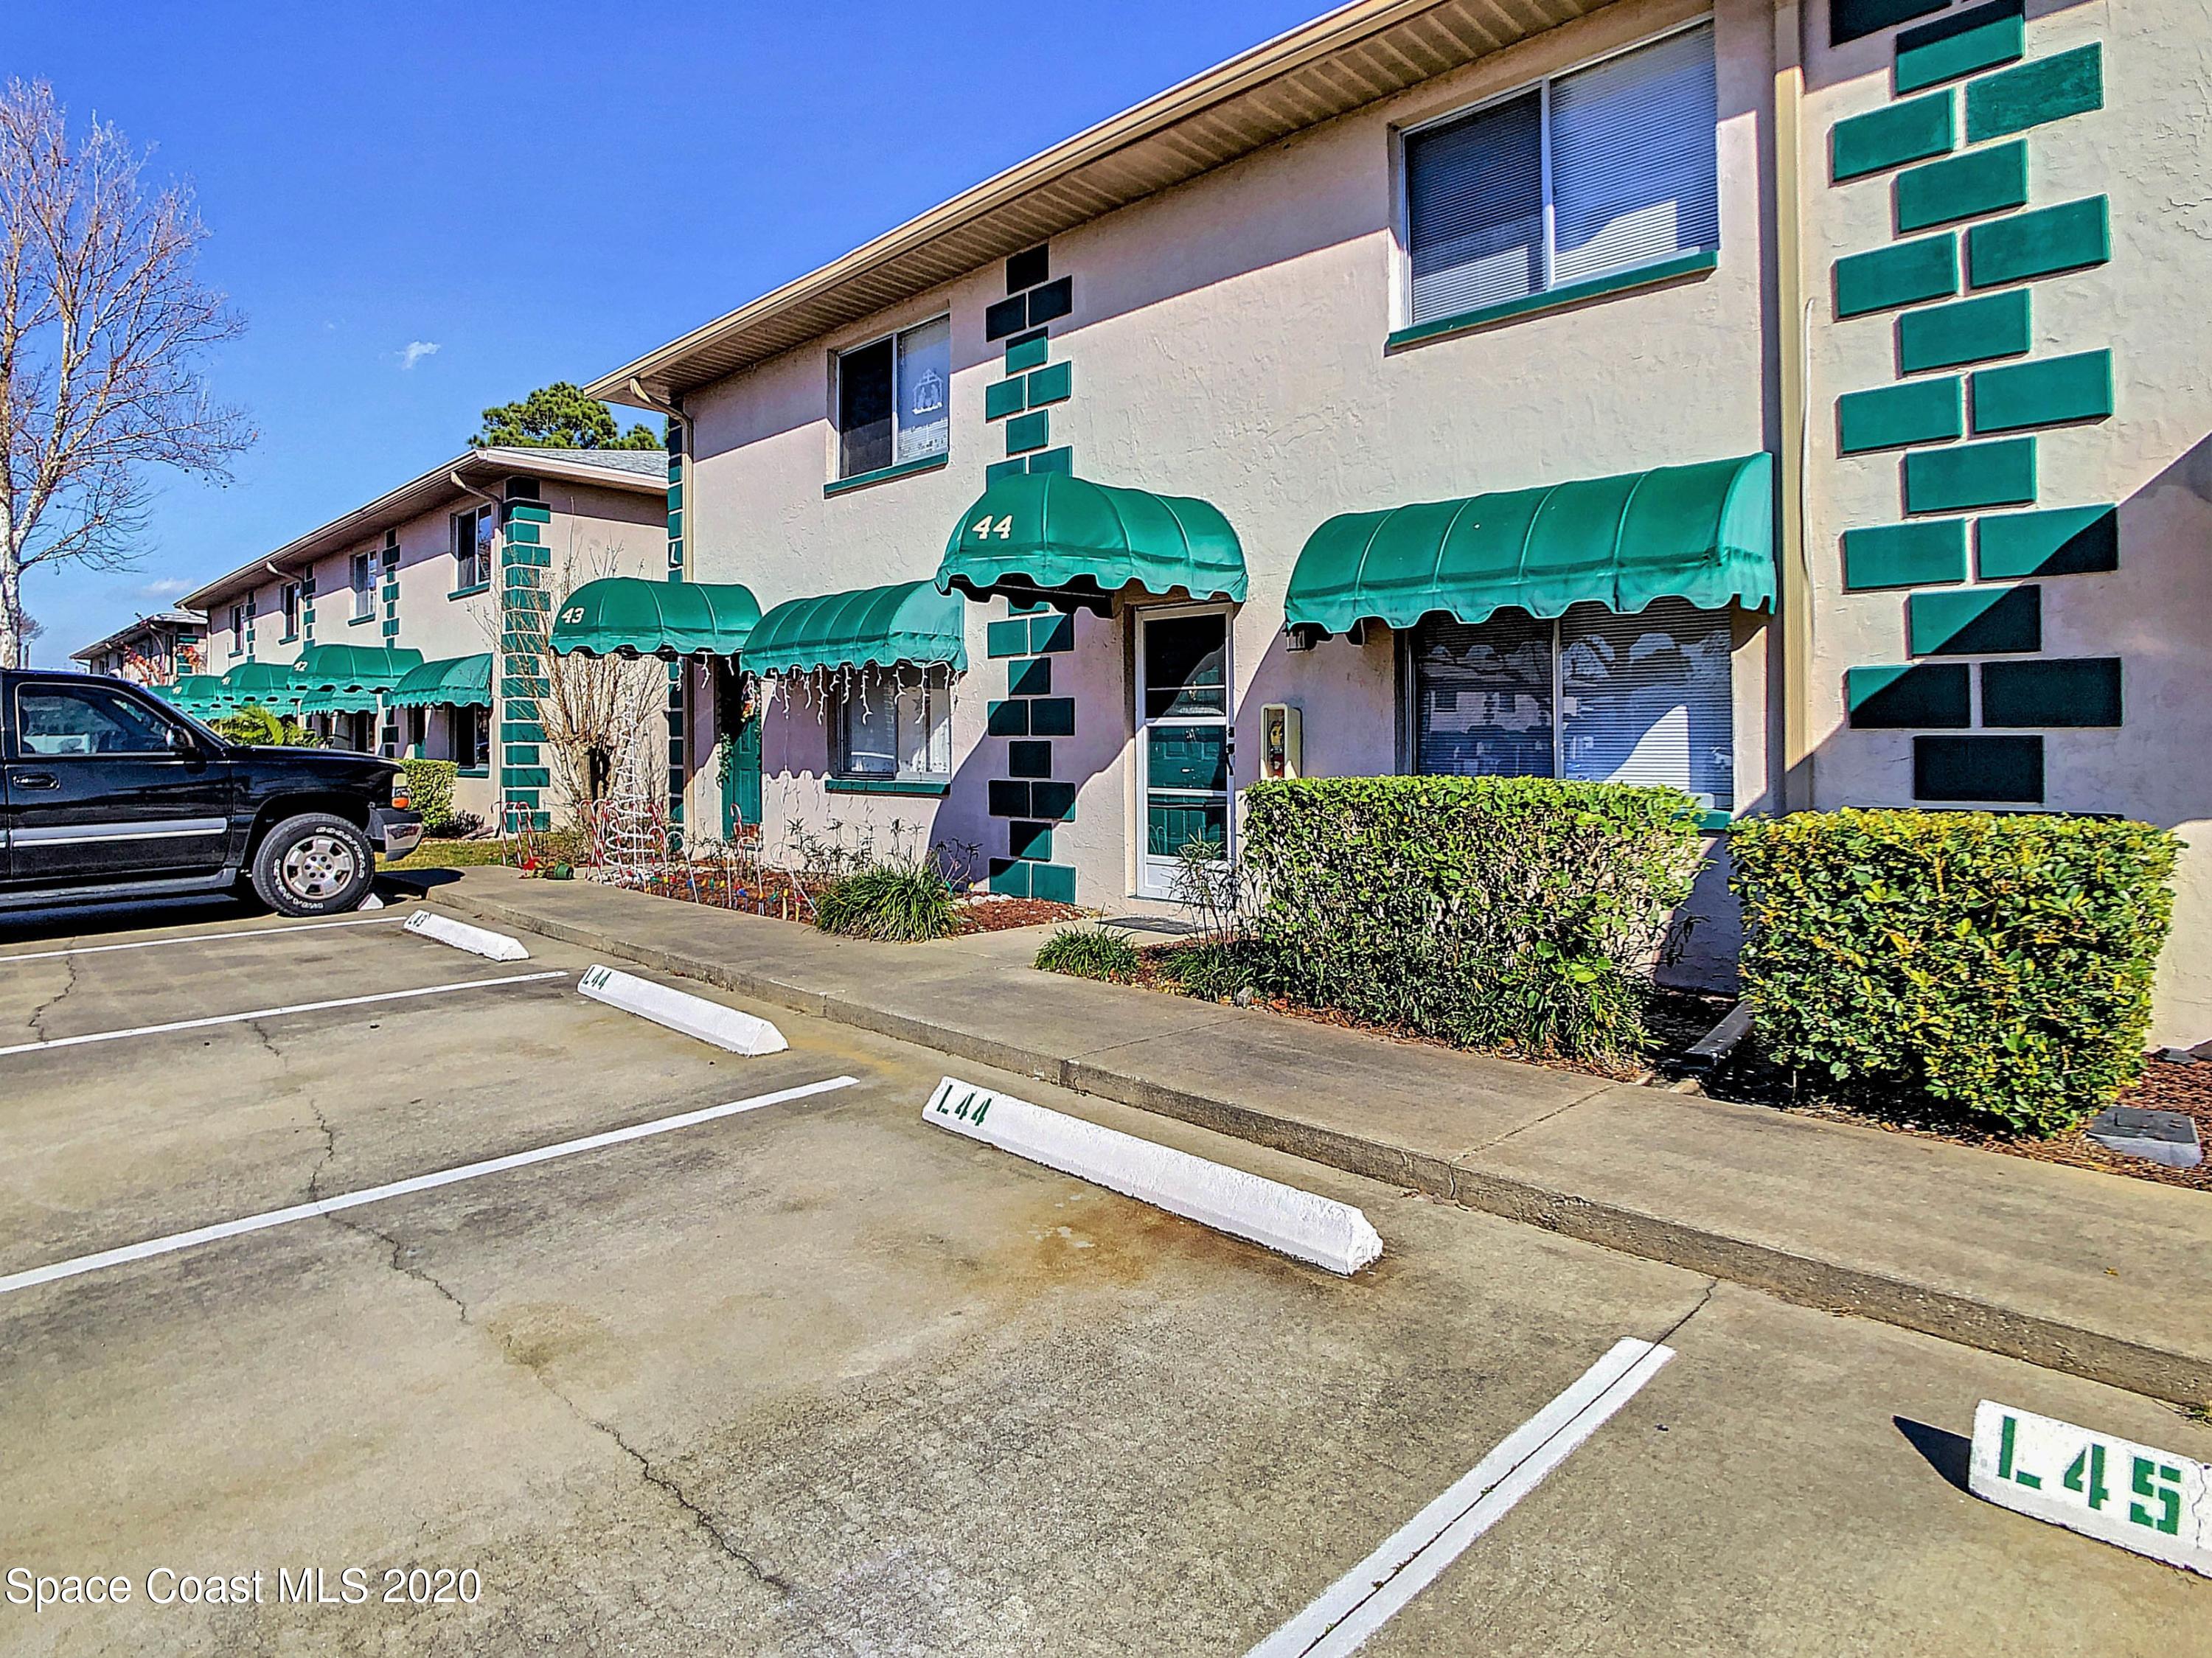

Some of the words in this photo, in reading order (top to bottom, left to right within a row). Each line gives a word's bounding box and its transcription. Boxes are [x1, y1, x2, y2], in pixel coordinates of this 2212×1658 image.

[972, 515, 1013, 540] 44
[561, 607, 585, 624] 43
[293, 661, 308, 672] 42
[582, 966, 612, 990] L44
[936, 1084, 992, 1126] L44
[1997, 1415, 2183, 1536] L45
